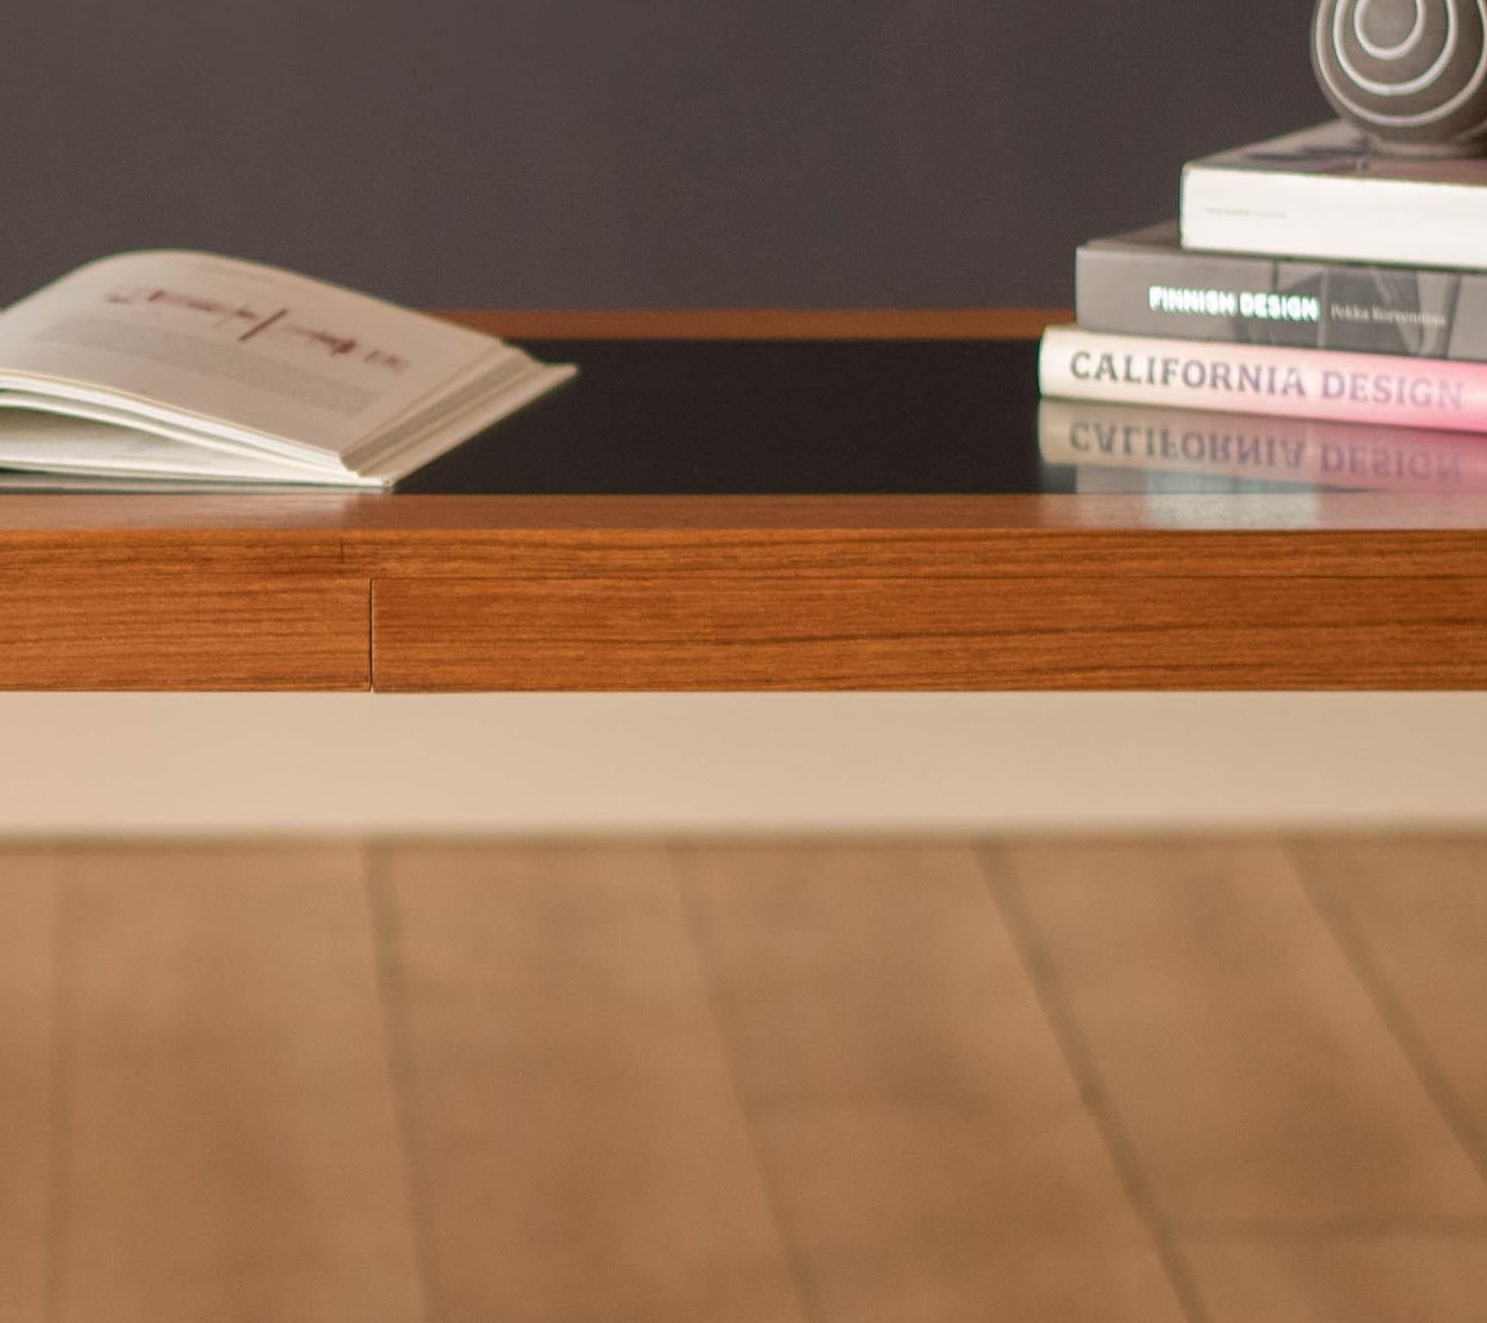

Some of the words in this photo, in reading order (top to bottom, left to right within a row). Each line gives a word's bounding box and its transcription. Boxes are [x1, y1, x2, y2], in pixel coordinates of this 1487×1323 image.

[1149, 285, 1236, 316] FINNISH
[1239, 291, 1320, 322] DESIGN
[1069, 350, 1306, 398] CALIFORNIA
[1320, 369, 1465, 410] DESIGN
